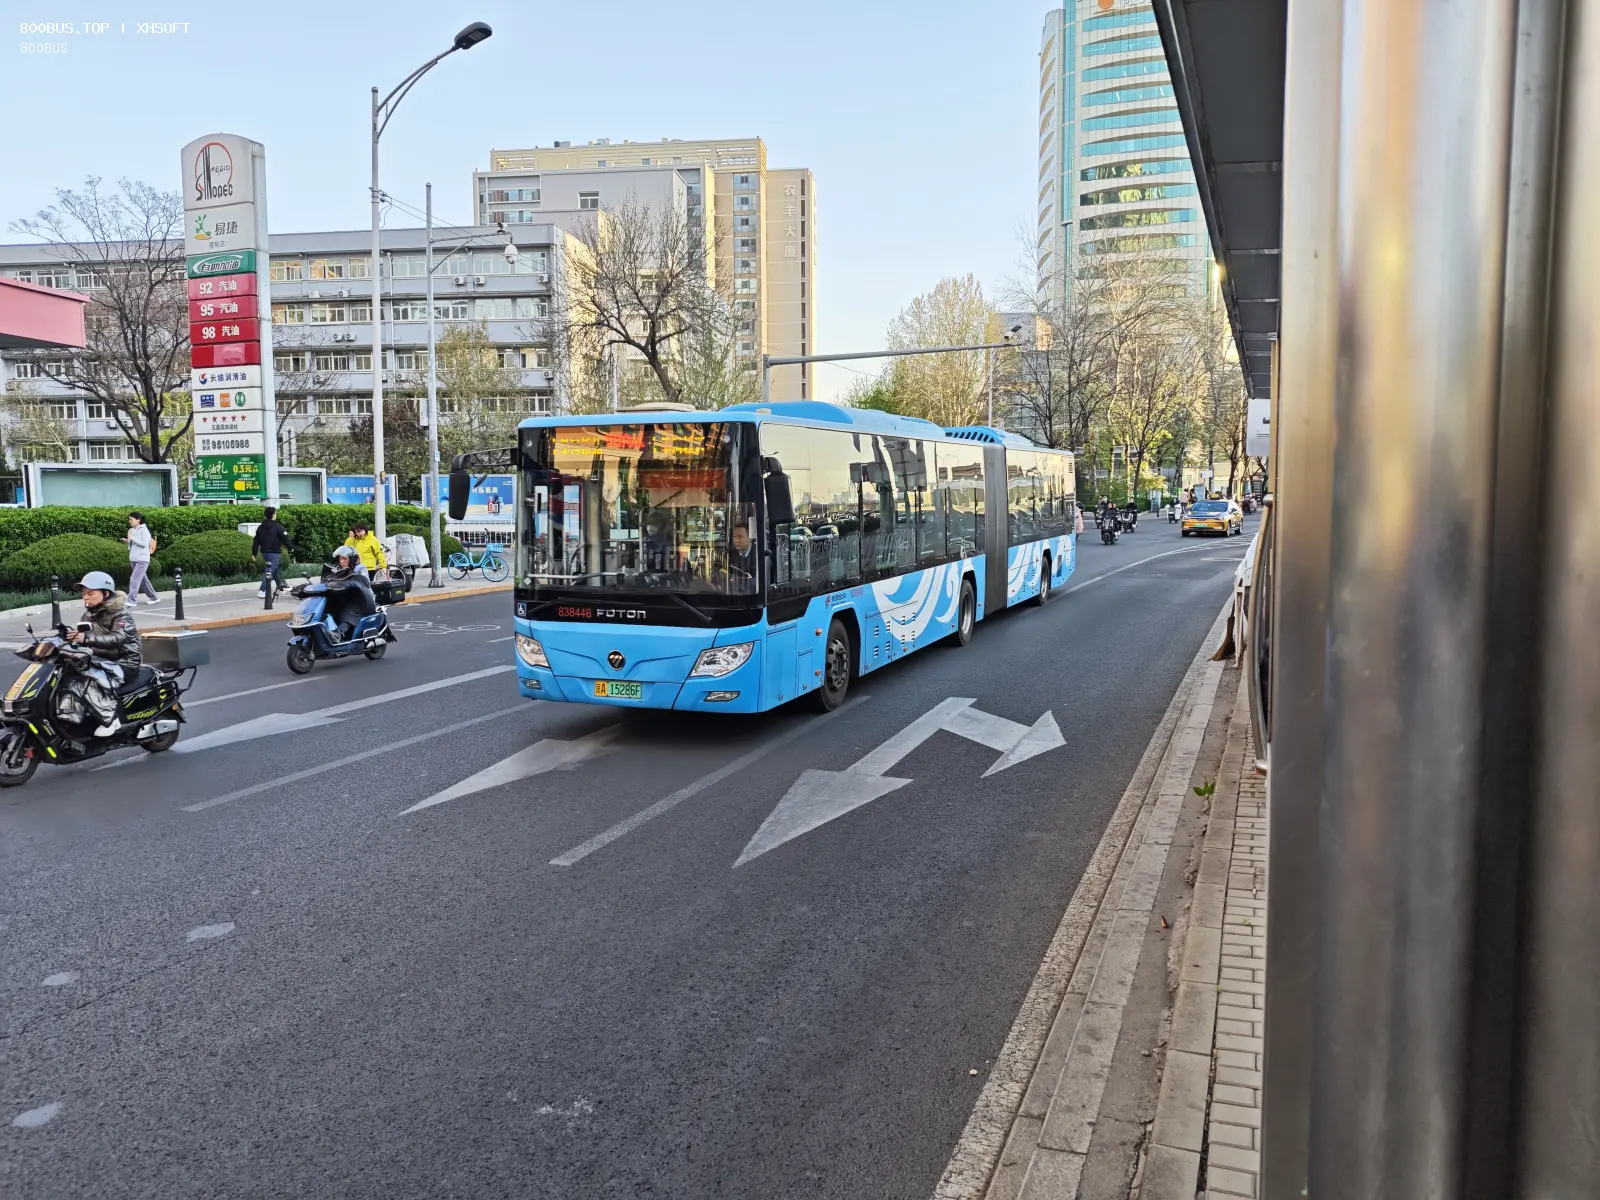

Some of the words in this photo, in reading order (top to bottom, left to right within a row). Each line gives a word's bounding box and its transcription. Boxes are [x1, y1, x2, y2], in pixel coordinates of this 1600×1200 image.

[784, 184, 796, 257] 农丰大厦
[215, 221, 238, 235] 易捷
[201, 261, 240, 271] 自助加油
[200, 282, 212, 294] 92
[219, 280, 237, 291] 汽油
[201, 304, 214, 316] 95
[220, 302, 238, 313] 汽油
[202, 326, 216, 339] 98
[222, 325, 240, 336] 汽油
[210, 372, 247, 382] 长城润滑油
[212, 440, 250, 450] 95105988
[558, 607, 592, 618] 838446
[597, 608, 646, 619] FOTON
